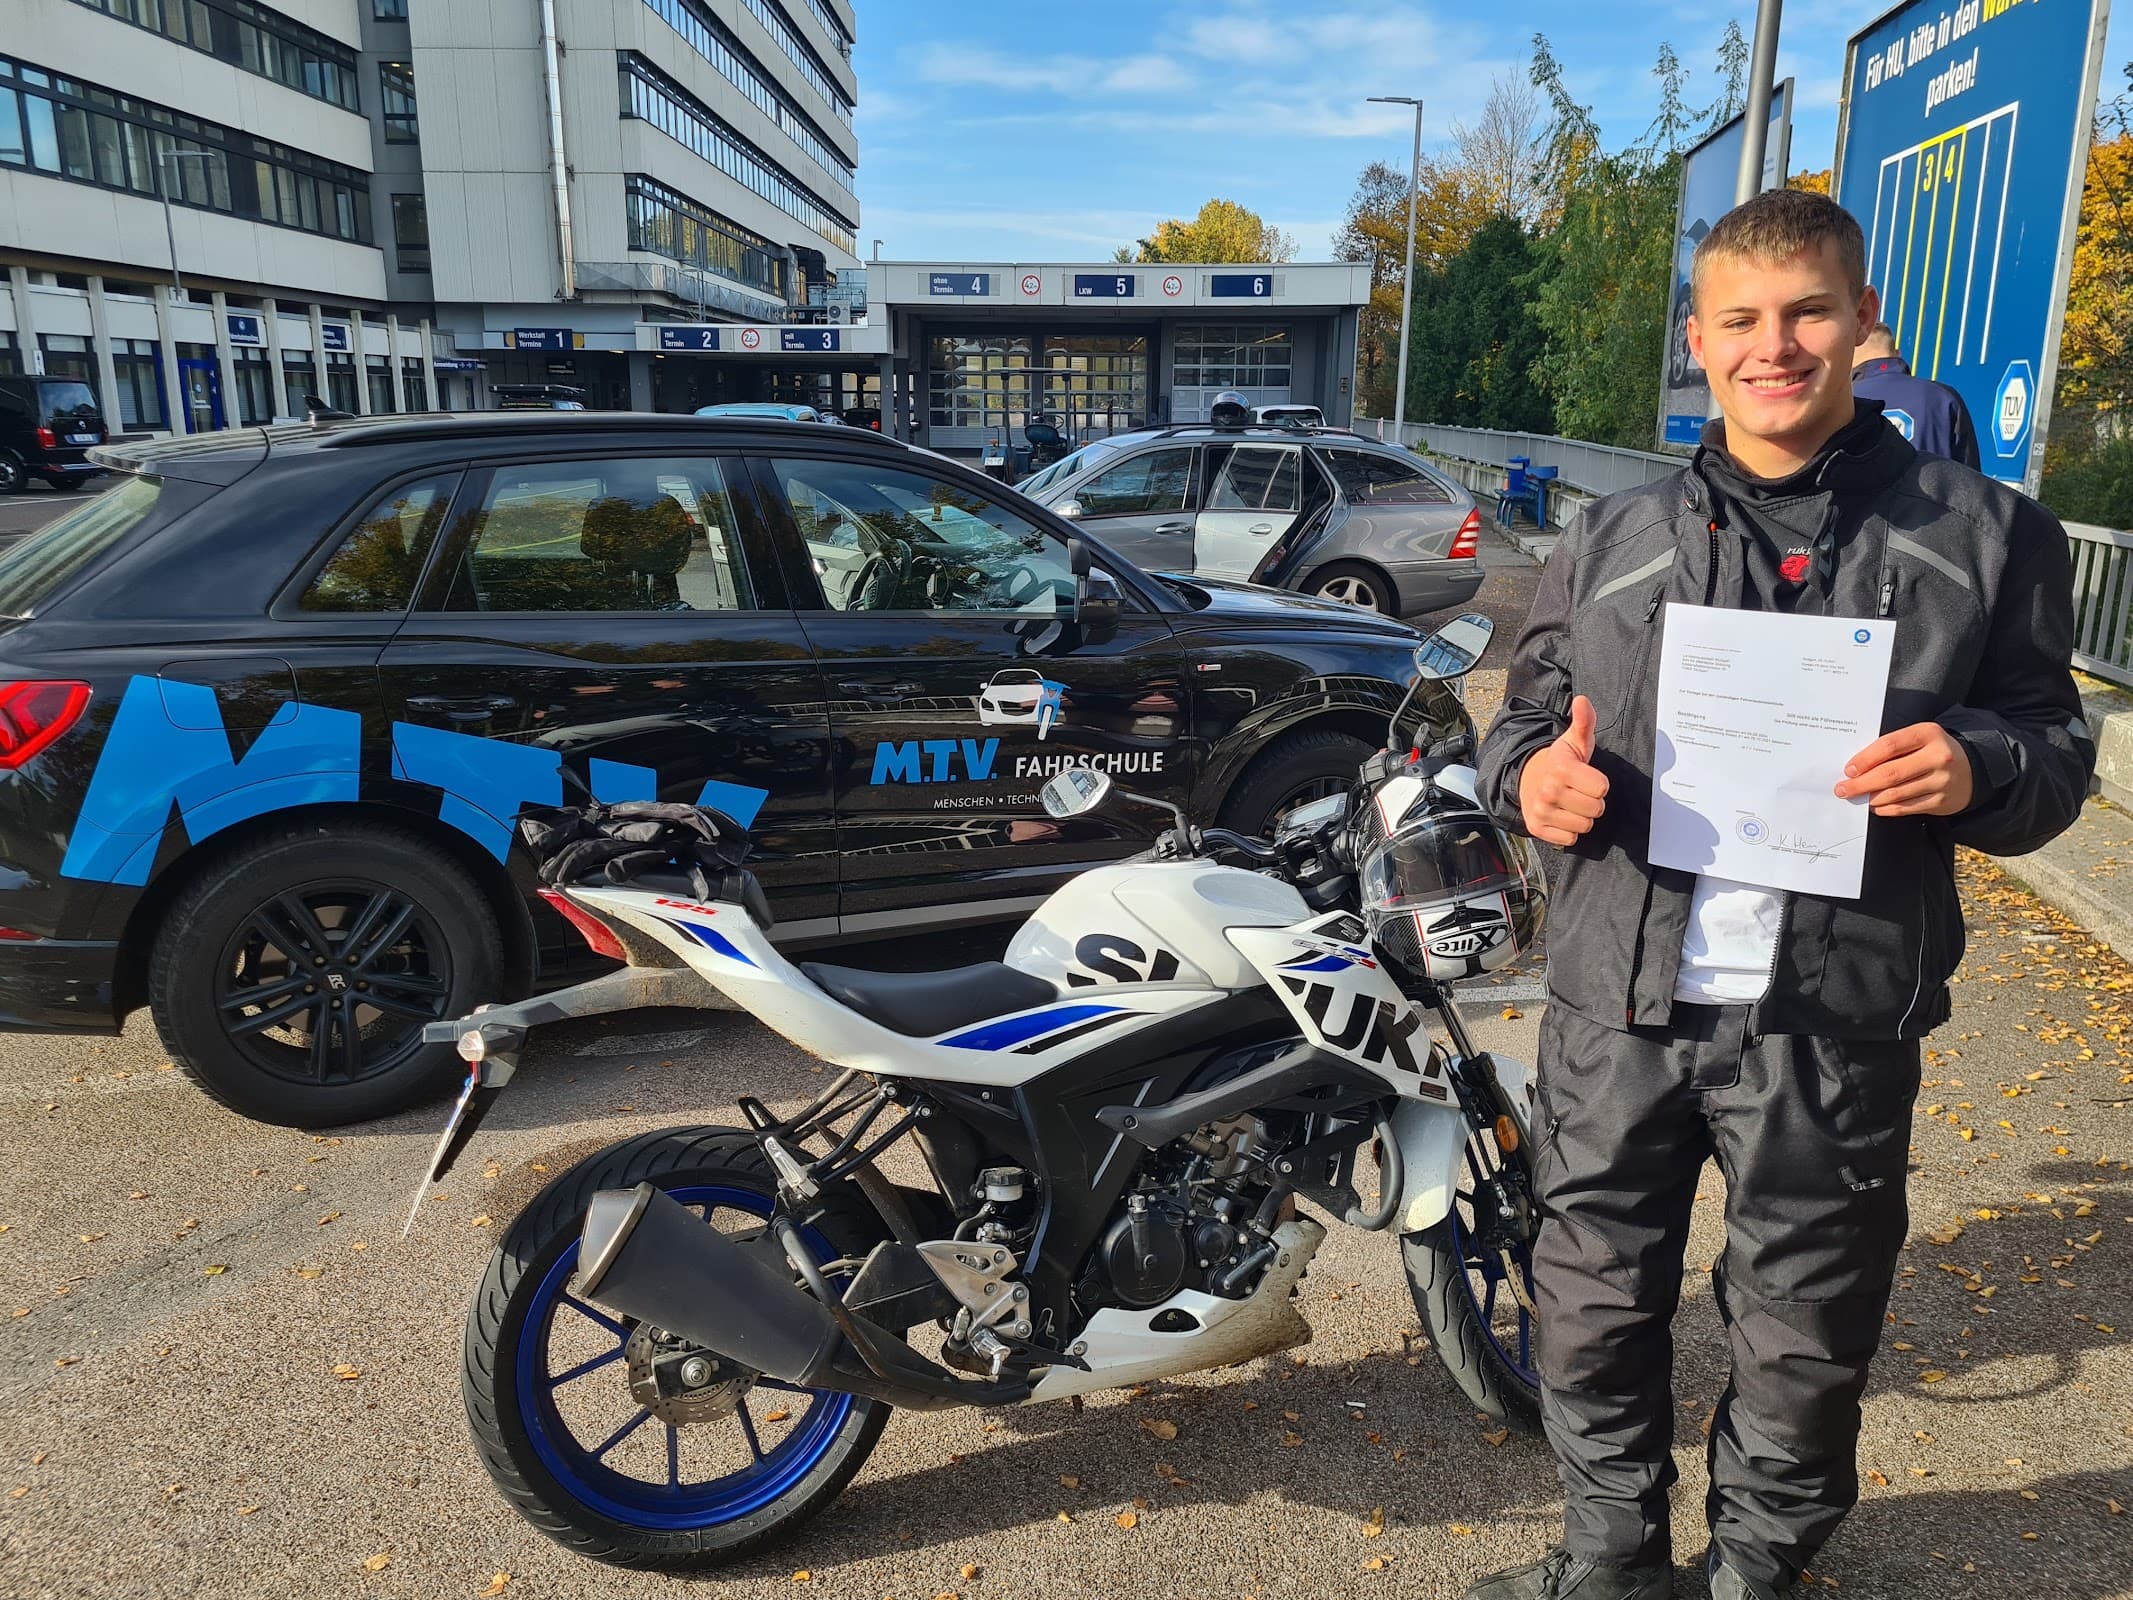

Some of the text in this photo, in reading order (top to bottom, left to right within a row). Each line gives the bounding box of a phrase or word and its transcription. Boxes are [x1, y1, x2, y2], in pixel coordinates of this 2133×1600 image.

[1864, 52, 1886, 92] Für
[1884, 37, 1905, 80] HU,
[1907, 22, 1936, 67] bitte
[1937, 12, 1951, 50] in
[1952, 0, 1979, 41] den
[1925, 46, 1979, 118] parken!
[1923, 144, 1956, 192] 3 4
[971, 276, 981, 294] 4
[1078, 287, 1093, 295] LKW
[1116, 277, 1126, 295] 5
[1253, 277, 1264, 295] 6
[555, 331, 564, 348] 1
[702, 331, 712, 348] 2
[822, 332, 832, 349] 3
[870, 737, 1164, 785] M.T.V. FAHRSCHULE
[933, 793, 1044, 809] MENSCHEN TECHN
[1435, 924, 1500, 954] X-lite
